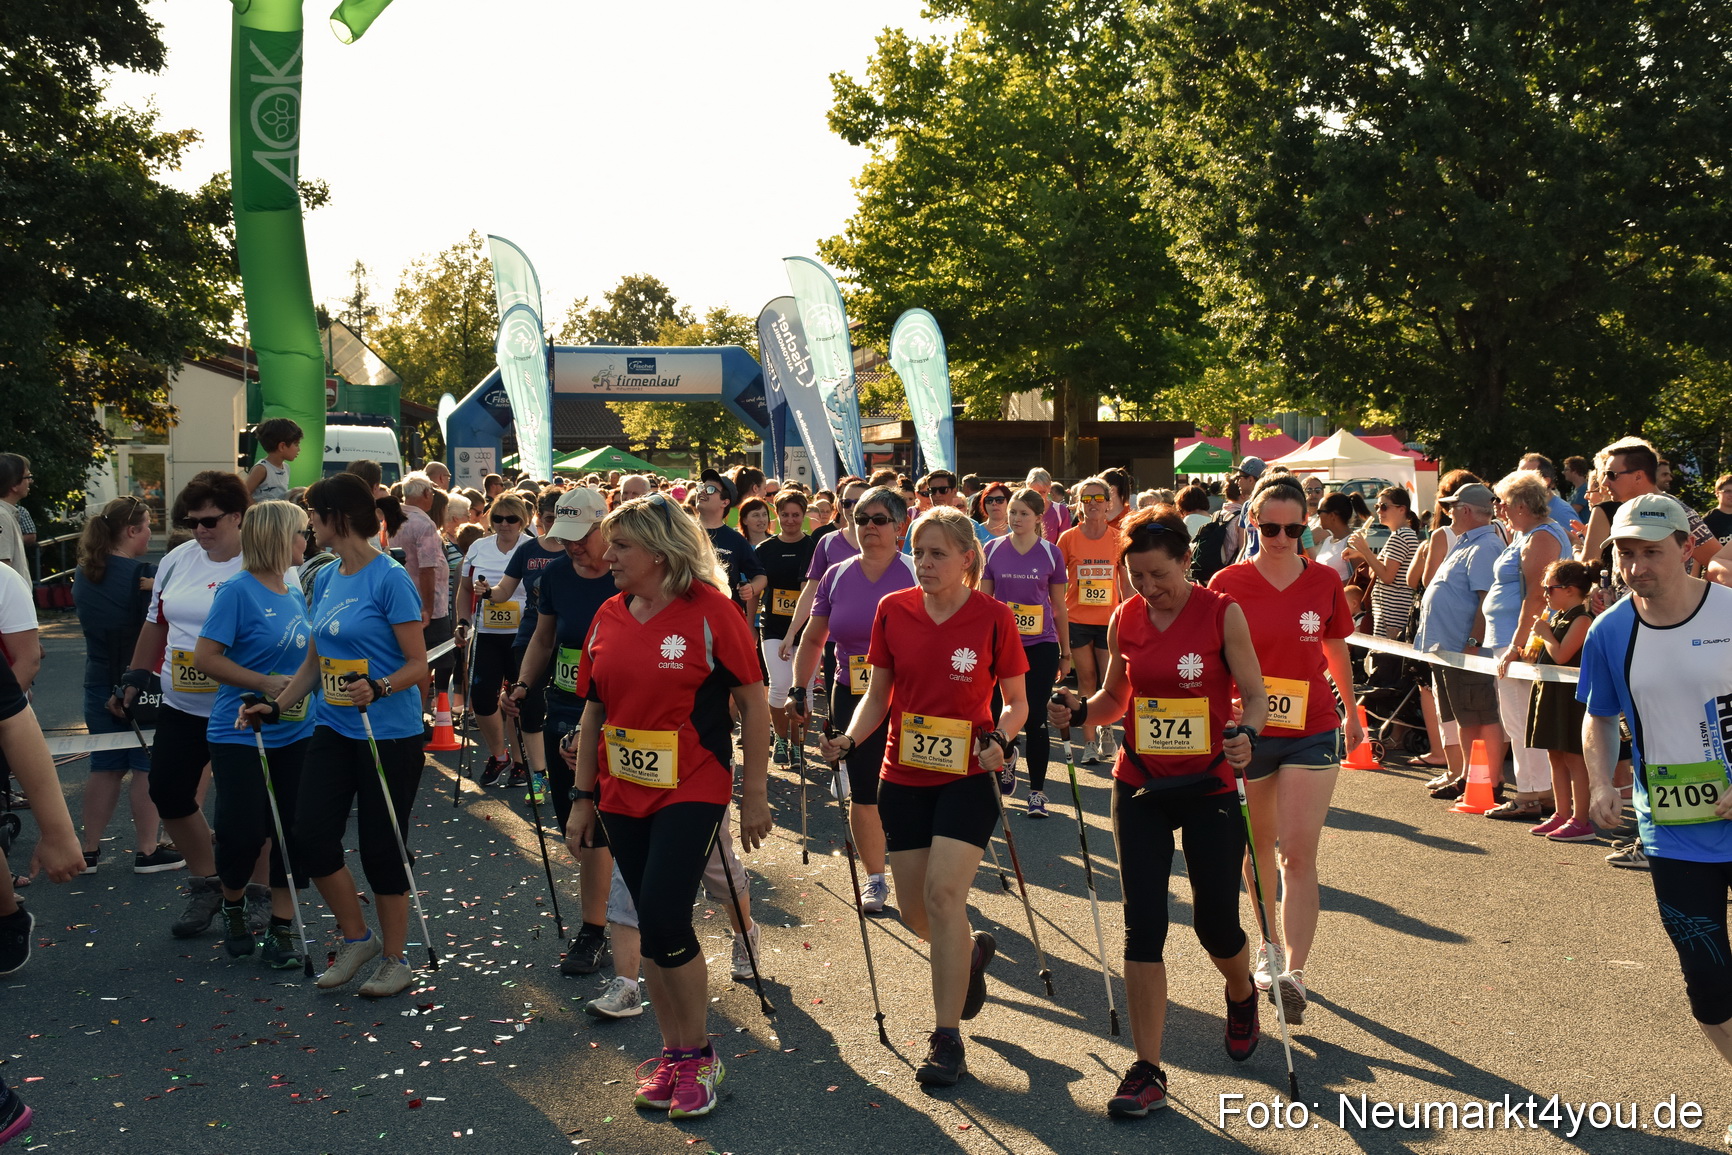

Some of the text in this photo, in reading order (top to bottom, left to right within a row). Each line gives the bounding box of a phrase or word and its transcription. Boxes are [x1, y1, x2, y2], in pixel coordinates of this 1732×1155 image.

[249, 38, 303, 193] AOK
[616, 375, 681, 387] firmenlauf
[492, 394, 511, 404] Fisc
[1080, 567, 1112, 577] OBI
[1086, 588, 1106, 599] 892
[777, 598, 796, 609] 164
[490, 610, 512, 621] 263
[658, 660, 684, 670] caritas
[859, 668, 871, 683] 4
[949, 673, 973, 683] caritas
[1178, 681, 1203, 689] caritas
[1267, 694, 1291, 714] 60
[1149, 718, 1192, 739] 374
[913, 733, 953, 757] 373
[1152, 740, 1173, 748] Helgert
[1699, 720, 1713, 762] WASTE WA
[618, 747, 659, 772] 362
[911, 752, 953, 764] Simon Christine
[637, 770, 659, 778] Mireille
[1655, 783, 1719, 808] 2109
